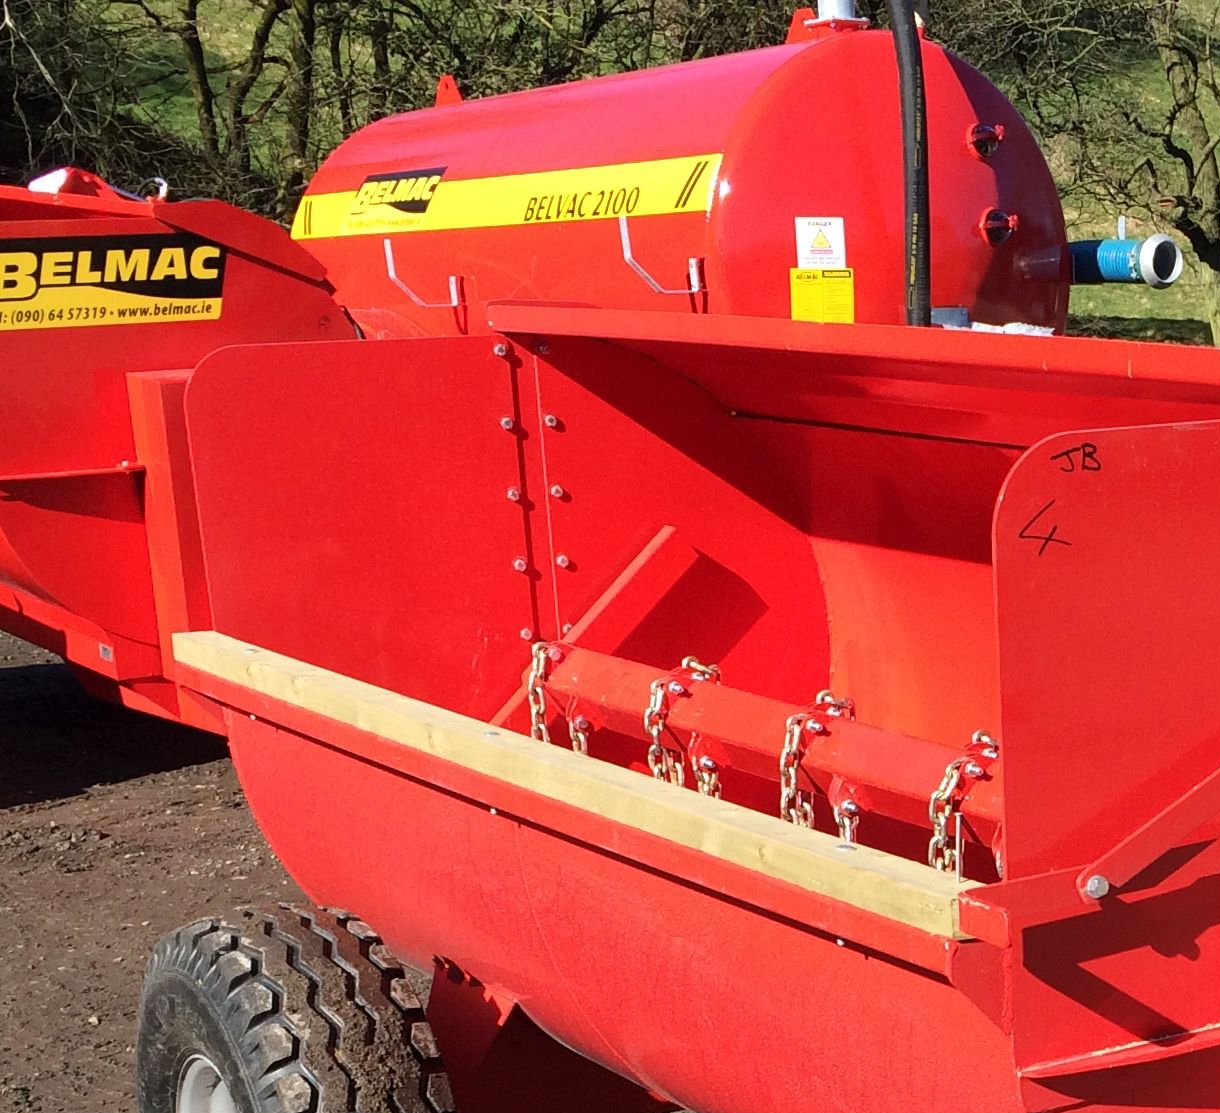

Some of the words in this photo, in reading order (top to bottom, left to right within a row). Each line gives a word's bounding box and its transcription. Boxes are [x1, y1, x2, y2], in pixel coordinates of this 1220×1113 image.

[351, 175, 441, 214] BELMAC
[524, 191, 592, 221] BELVAC
[592, 187, 640, 216] 2100
[0, 246, 220, 299] BELMAC
[11, 309, 44, 325] (090)
[117, 301, 213, 318] www.belmac.ie
[1050, 443, 1101, 472] JB
[1018, 499, 1073, 557] 4
